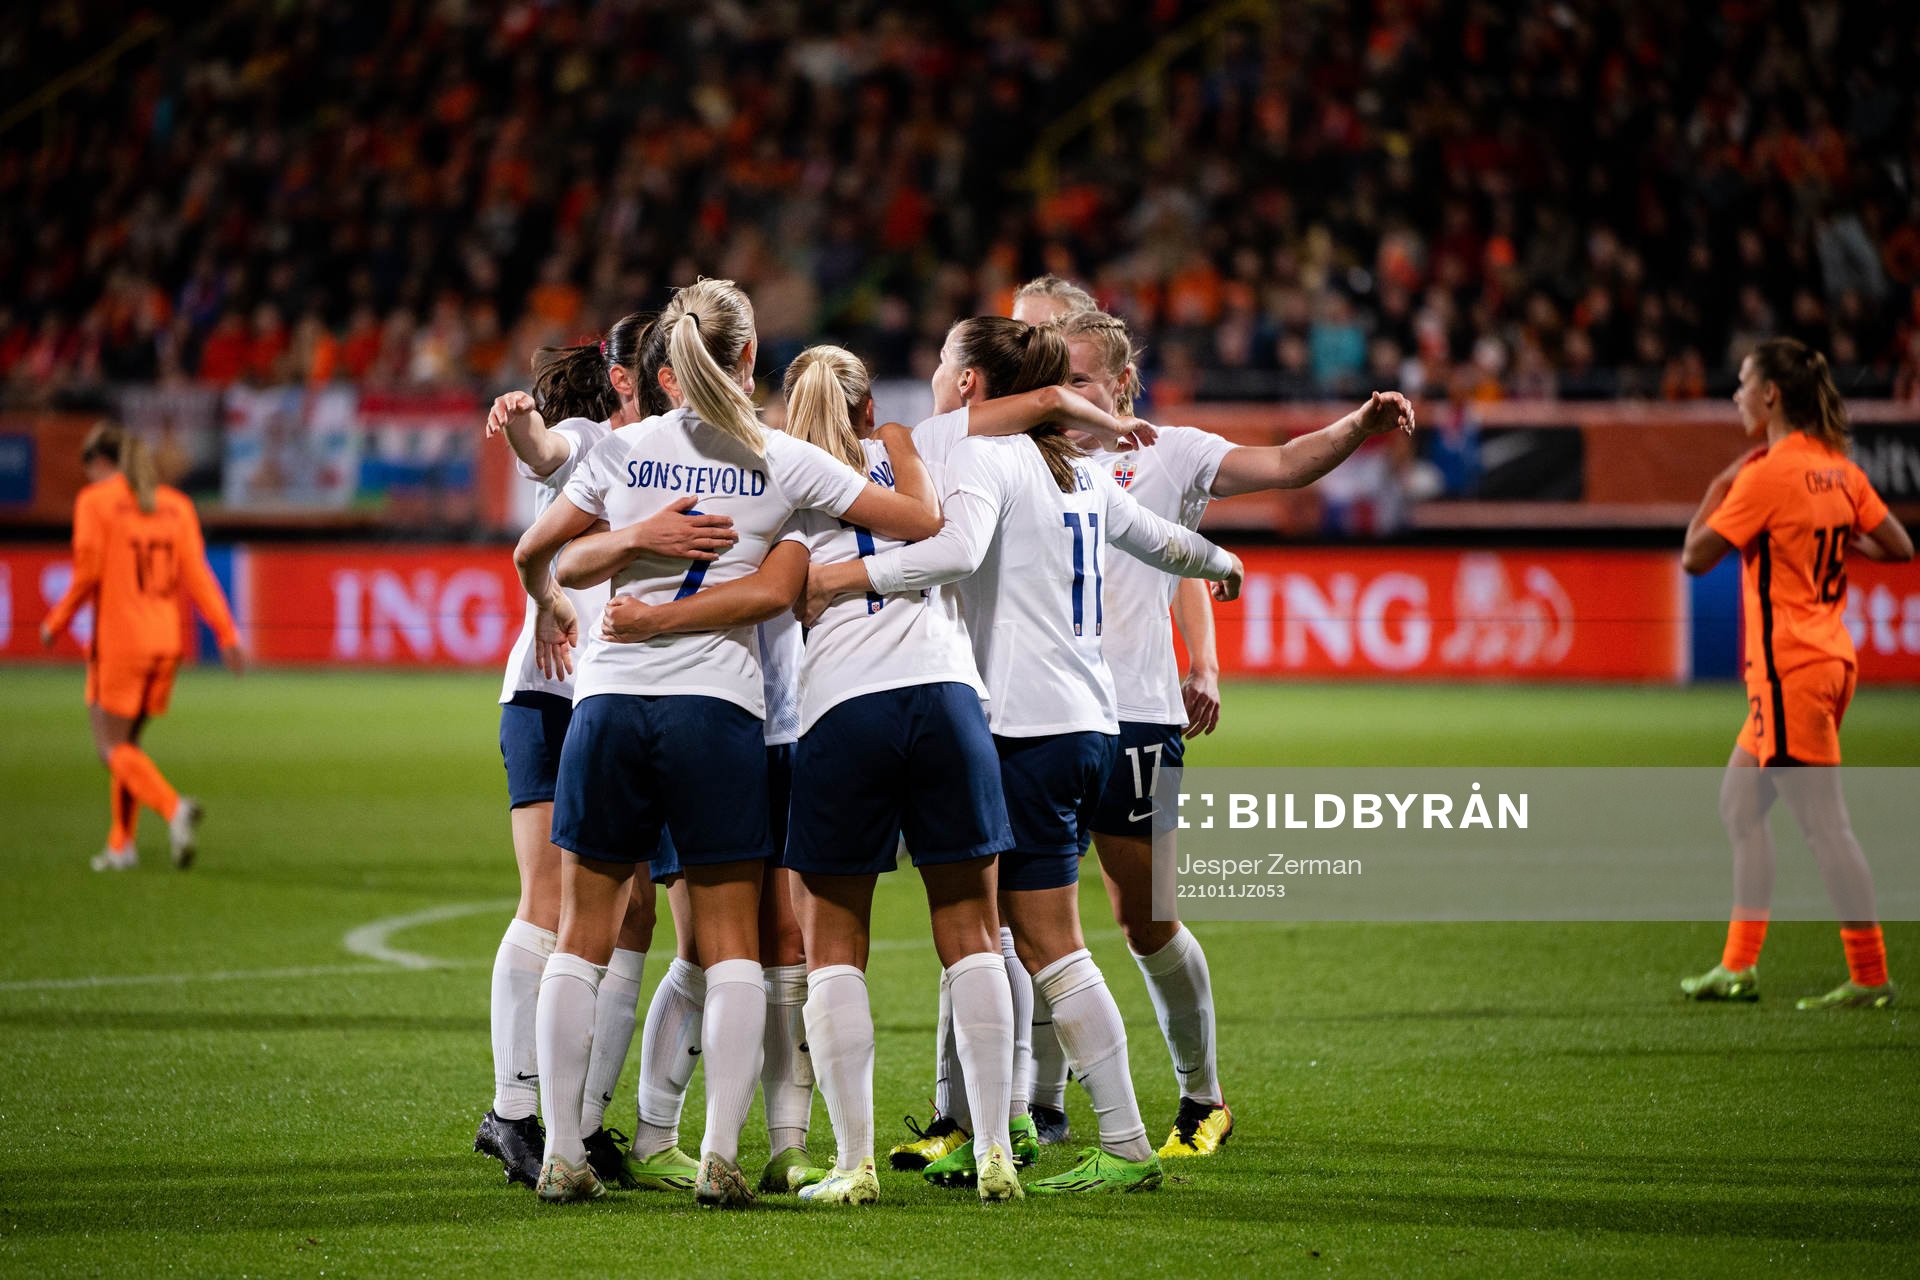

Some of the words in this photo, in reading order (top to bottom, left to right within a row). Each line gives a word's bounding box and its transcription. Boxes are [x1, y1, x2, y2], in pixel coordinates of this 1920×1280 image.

[627, 460, 766, 497] SØNSTEVOLD
[1063, 512, 1103, 637] 11
[1814, 524, 1851, 604] 18
[331, 568, 506, 664] ING
[1244, 570, 1432, 671] ING
[1125, 743, 1164, 799] 17
